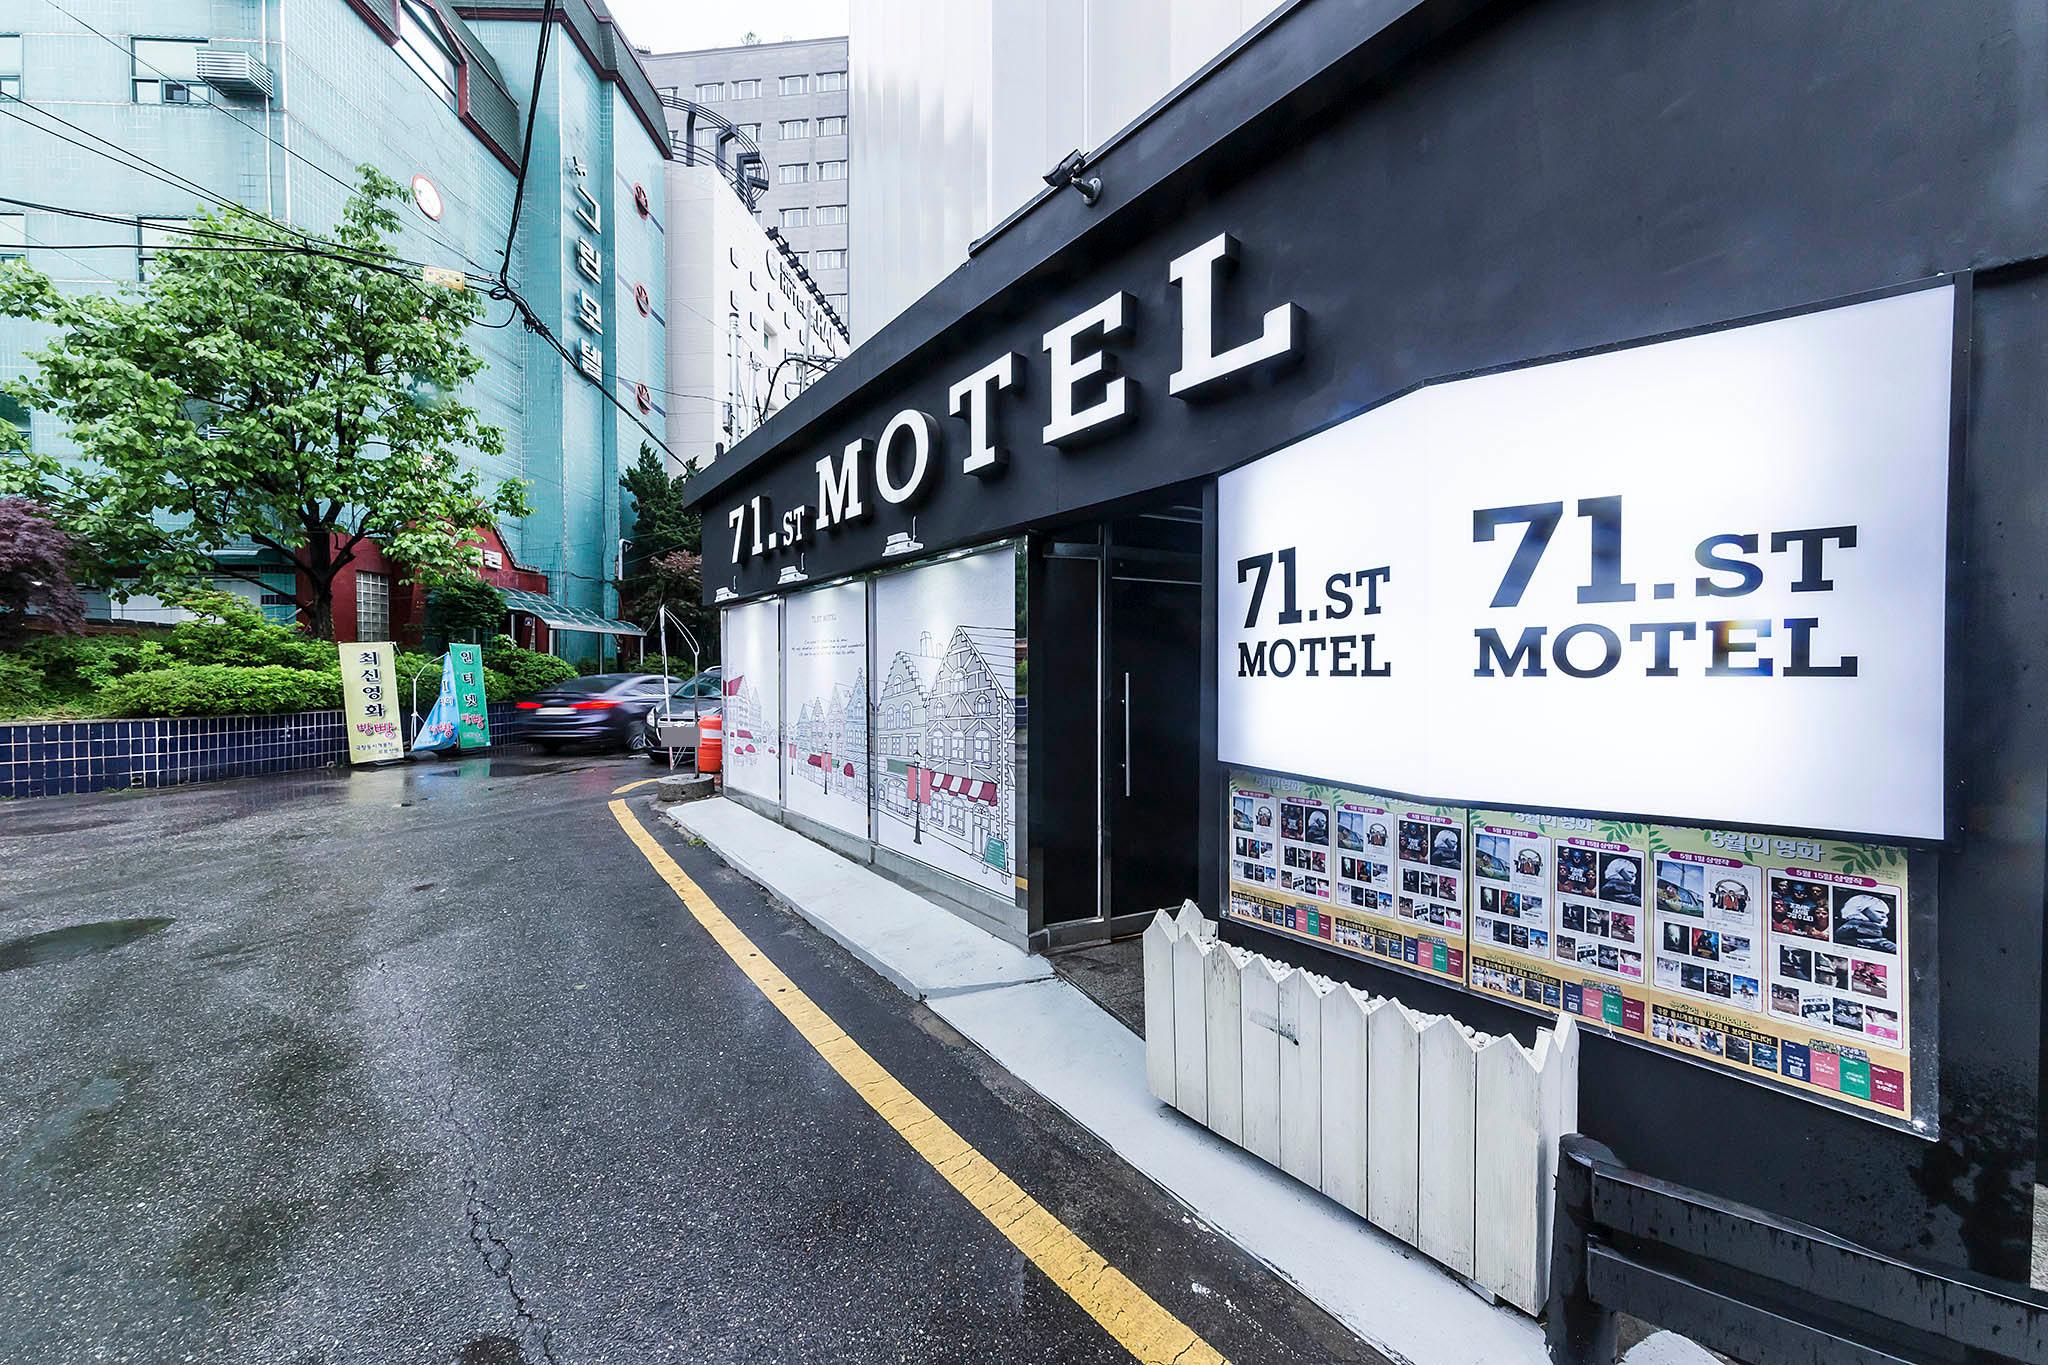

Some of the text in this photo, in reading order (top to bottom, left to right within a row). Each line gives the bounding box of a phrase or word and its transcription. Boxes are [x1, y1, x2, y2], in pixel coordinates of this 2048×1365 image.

[729, 232, 1292, 564] 71.ST MOTEL
[1473, 495, 1858, 608] 71.ST
[1237, 546, 1391, 629] 71.ST
[461, 651, 477, 707] 인터넷
[1237, 634, 1391, 678] MOTEL
[1474, 617, 1858, 680] MOTEL
[359, 651, 385, 717] 최신영화
[1711, 830, 1825, 862] 5월의 영화
[1796, 869, 1811, 878] 5월
